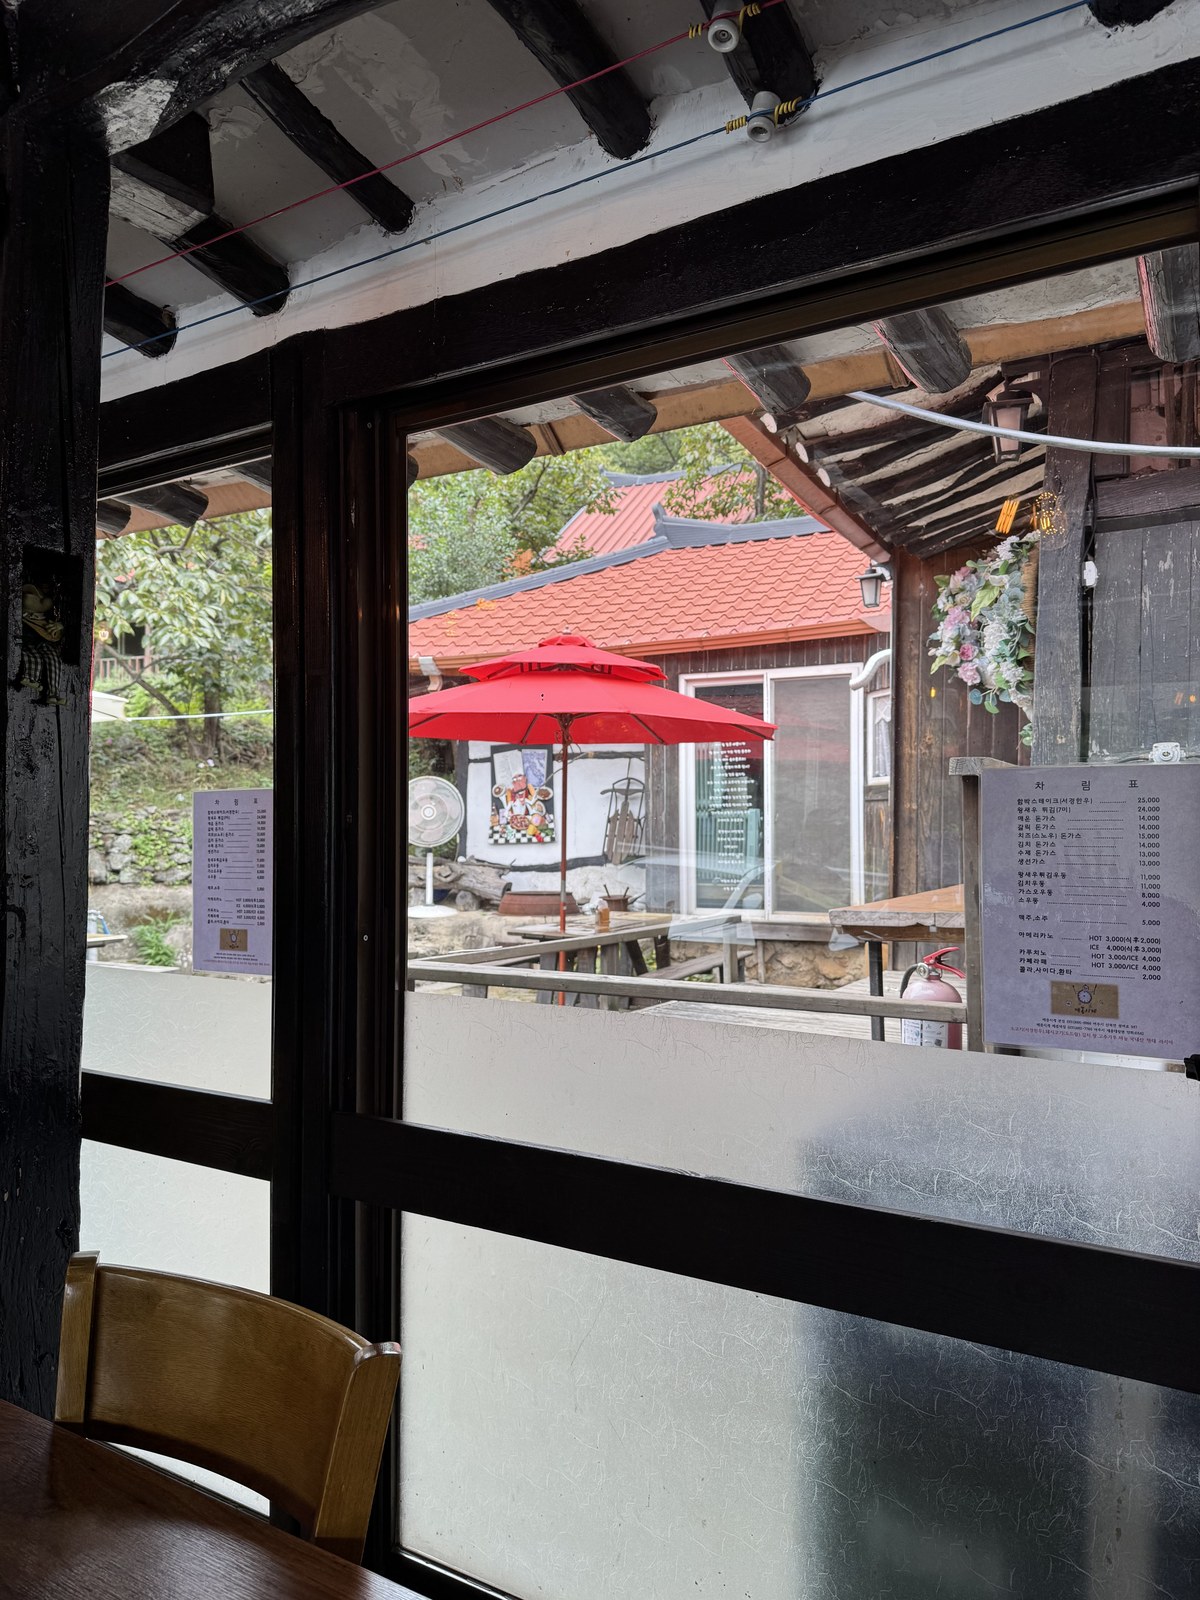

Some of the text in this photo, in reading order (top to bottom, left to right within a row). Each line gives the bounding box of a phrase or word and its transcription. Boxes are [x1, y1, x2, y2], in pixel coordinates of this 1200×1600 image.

[1035, 780, 1139, 791] 차 림 표
[1018, 880, 1046, 888] 김치우동
[1019, 949, 1047, 957] 카푸치노
[1108, 954, 1139, 962] 3,000/ICE
[1108, 963, 1139, 971] 3,000/ICE
